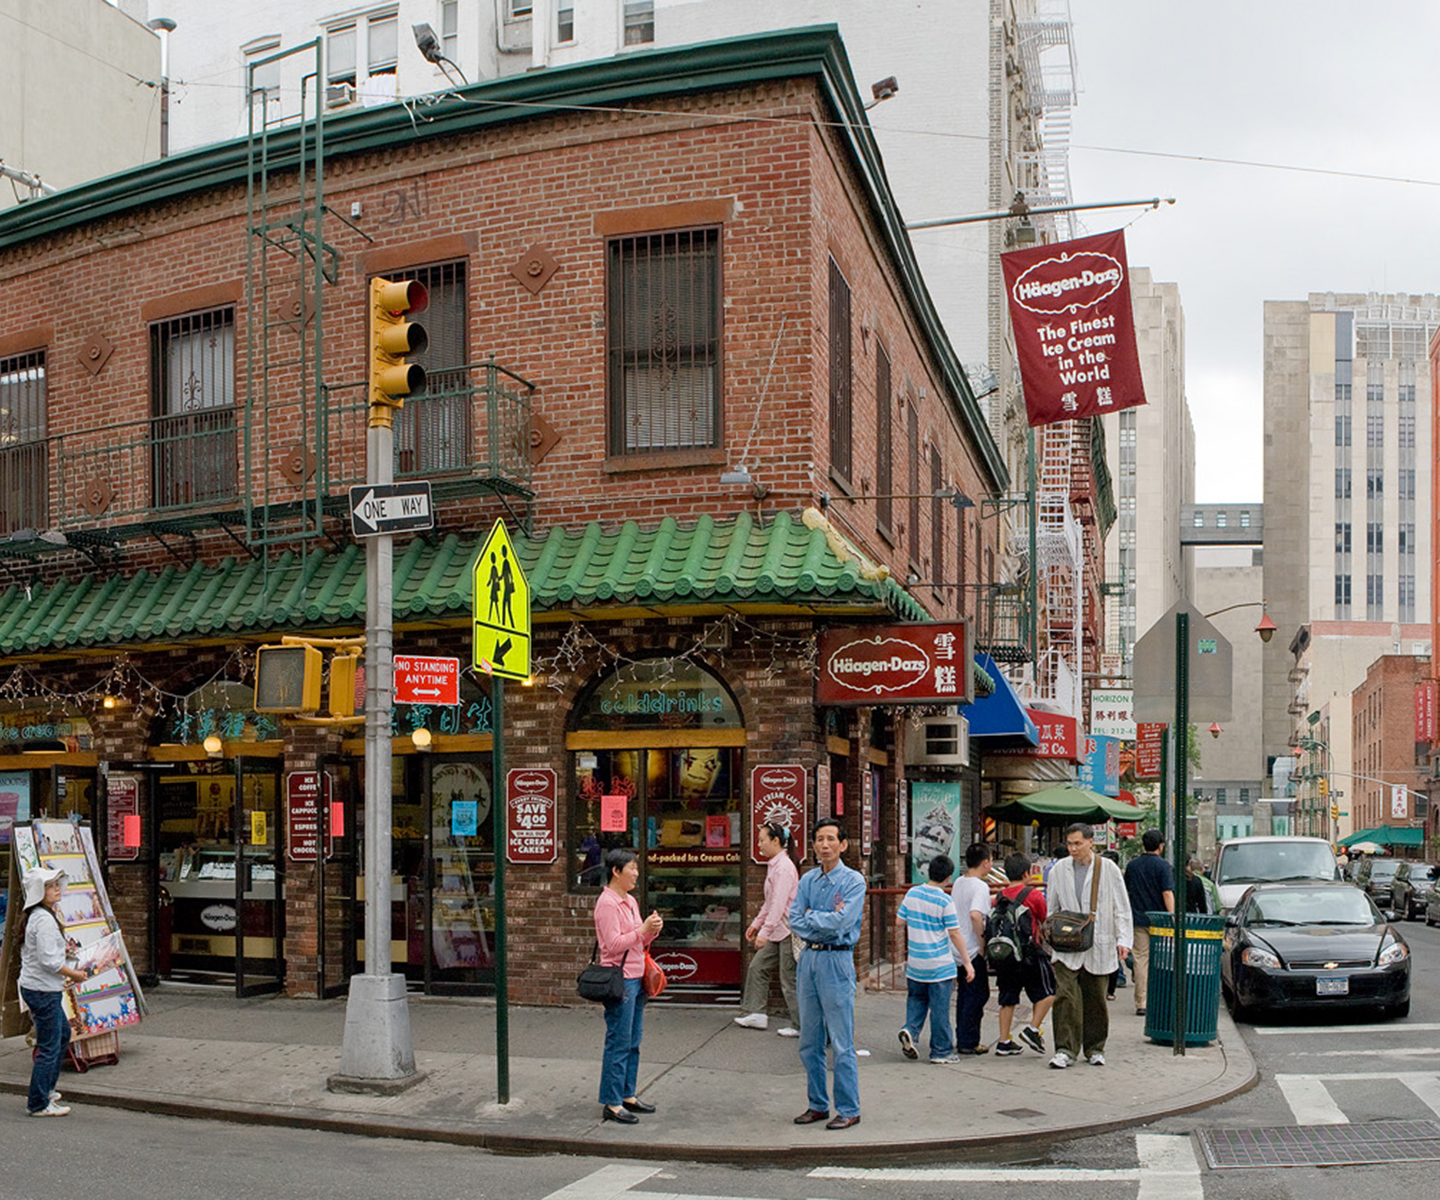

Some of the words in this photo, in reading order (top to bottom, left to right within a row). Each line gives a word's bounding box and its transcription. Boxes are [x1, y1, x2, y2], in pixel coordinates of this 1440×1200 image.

[1018, 266, 1120, 301] Häagen-Dazs
[1037, 326, 1066, 343] The
[1070, 315, 1115, 335] Finest
[1042, 341, 1064, 358] Ice
[1067, 333, 1116, 352] Cream
[1058, 357, 1074, 371] in
[1078, 350, 1105, 366] the
[1059, 364, 1110, 386] World
[363, 499, 387, 519] ONE
[401, 496, 426, 515] WAY
[398, 661, 410, 671] NO
[413, 661, 455, 674] STANDING
[833, 656, 926, 676] Häagen-Dazs
[404, 674, 448, 685] ANYTIME
[1093, 694, 1129, 703] HORIZON
[763, 792, 785, 803] CREAM
[785, 793, 803, 810] CAKES
[517, 804, 547, 814] SAVE
[509, 838, 522, 846] ICE
[524, 838, 553, 846] CREAM
[293, 846, 327, 854] CHOCOLE
[518, 846, 545, 854] CAKES
[647, 853, 687, 863] nd-packed
[688, 854, 698, 862] Ice
[700, 853, 724, 863] Cream
[725, 853, 741, 862] Cak
